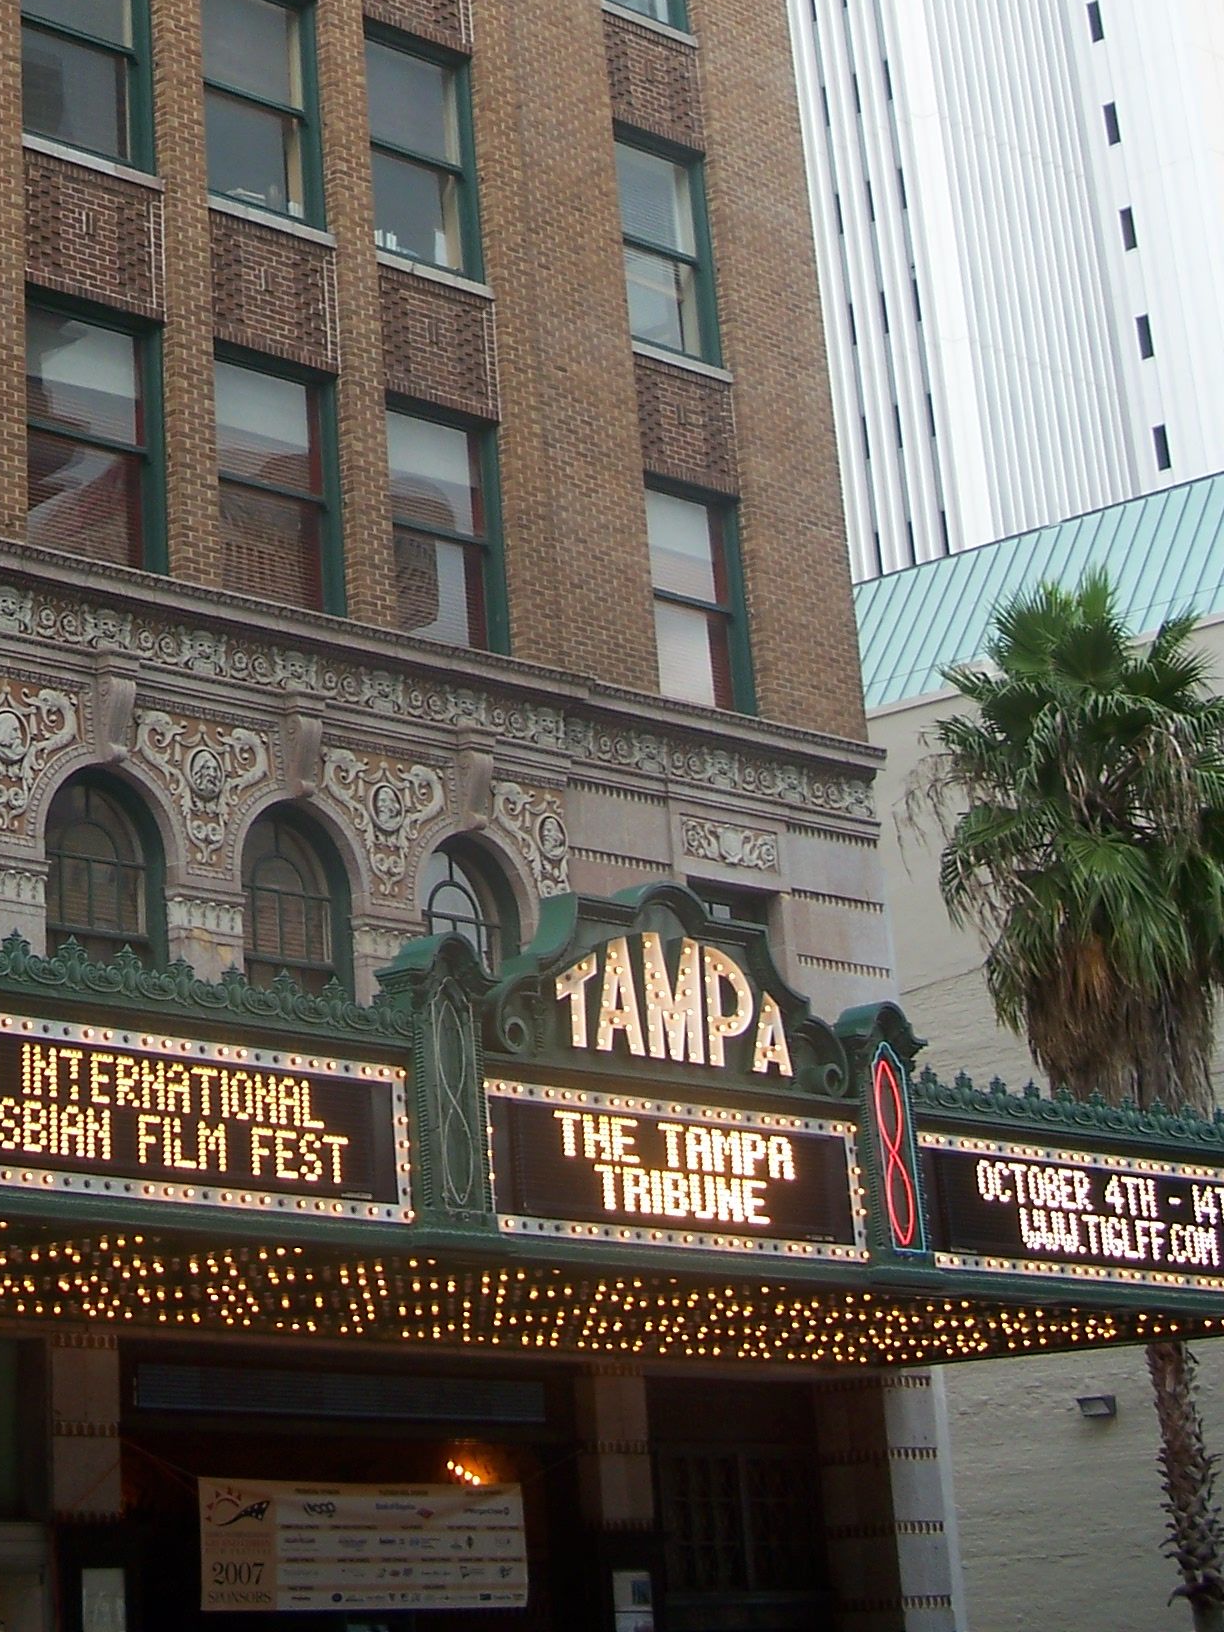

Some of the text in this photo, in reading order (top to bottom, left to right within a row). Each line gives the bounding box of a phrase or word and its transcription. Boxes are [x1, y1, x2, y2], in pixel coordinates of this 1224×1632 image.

[555, 931, 794, 1077] TAMPA
[22, 1044, 325, 1130] INTERNATIONAL
[138, 1114, 227, 1173] FILM
[251, 1126, 350, 1185] FEST
[554, 1111, 796, 1182] THE TAMPA
[595, 1164, 772, 1226] TRIBUNE
[976, 1159, 1093, 1211] OCTOBER
[1104, 1174, 1158, 1218] 4TH
[1019, 1206, 1220, 1267] WWW.TIGLFF.COM
[208, 1590, 273, 1605] SPONSORS
[212, 1561, 266, 1588] 2007
